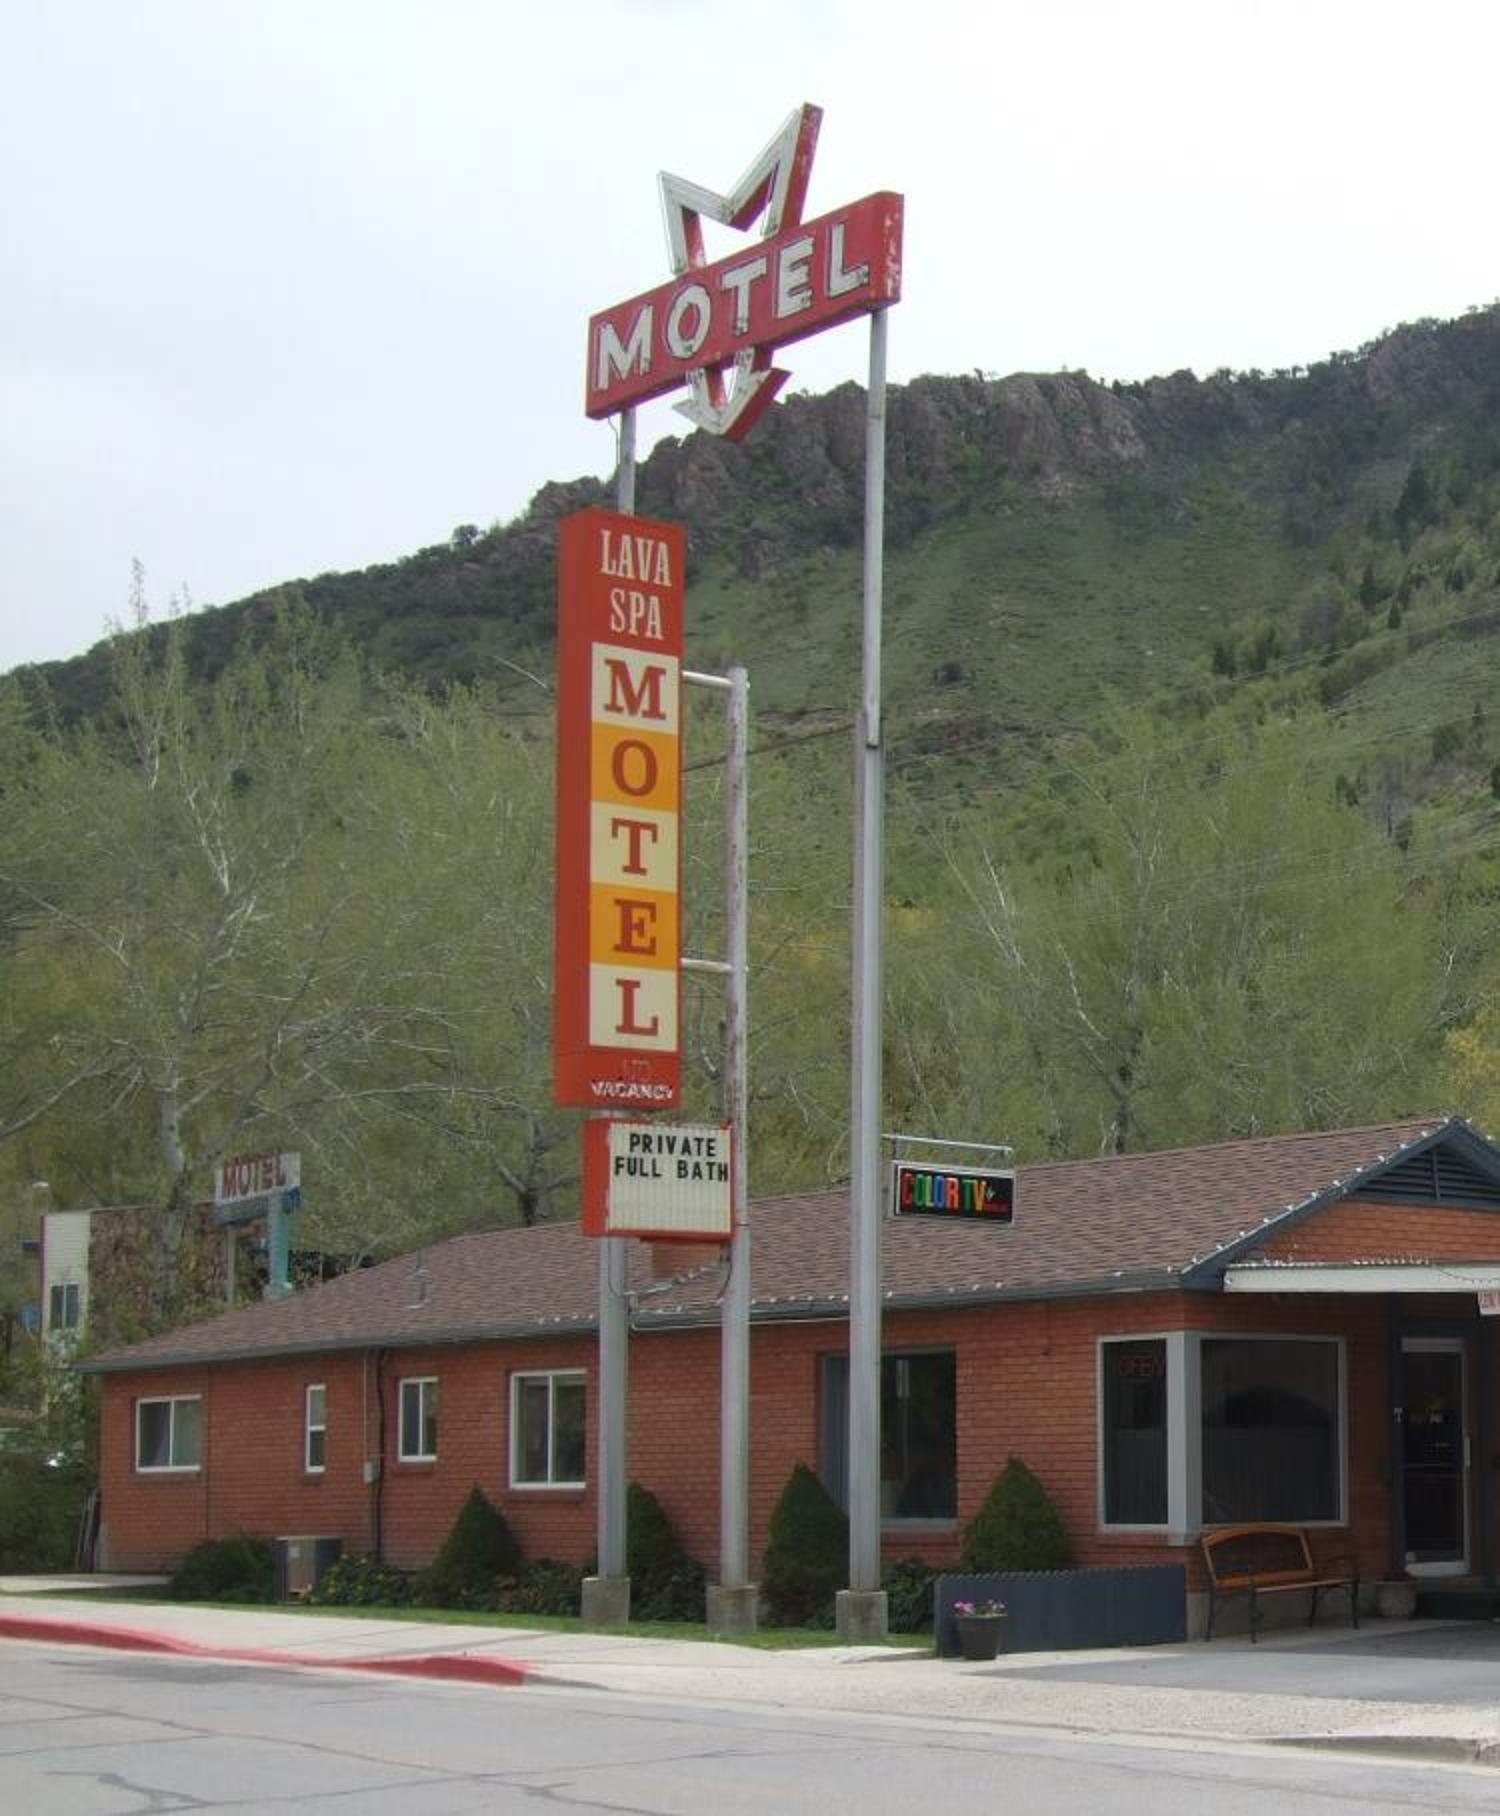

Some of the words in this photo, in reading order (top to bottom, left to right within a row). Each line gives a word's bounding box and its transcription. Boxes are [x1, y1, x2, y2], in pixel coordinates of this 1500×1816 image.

[596, 223, 869, 393] MOTEL
[600, 530, 672, 587] LAVA
[610, 588, 664, 640] SPA
[604, 659, 667, 1037] MOTEL
[592, 1080, 673, 1100] VACANCY
[629, 1133, 716, 1157] PRIVATE
[223, 1152, 286, 1198] MOTEL
[614, 1156, 662, 1177] FULL
[676, 1159, 728, 1182] BATH
[901, 1172, 959, 1211] COLOR
[962, 1178, 987, 1212] TV
